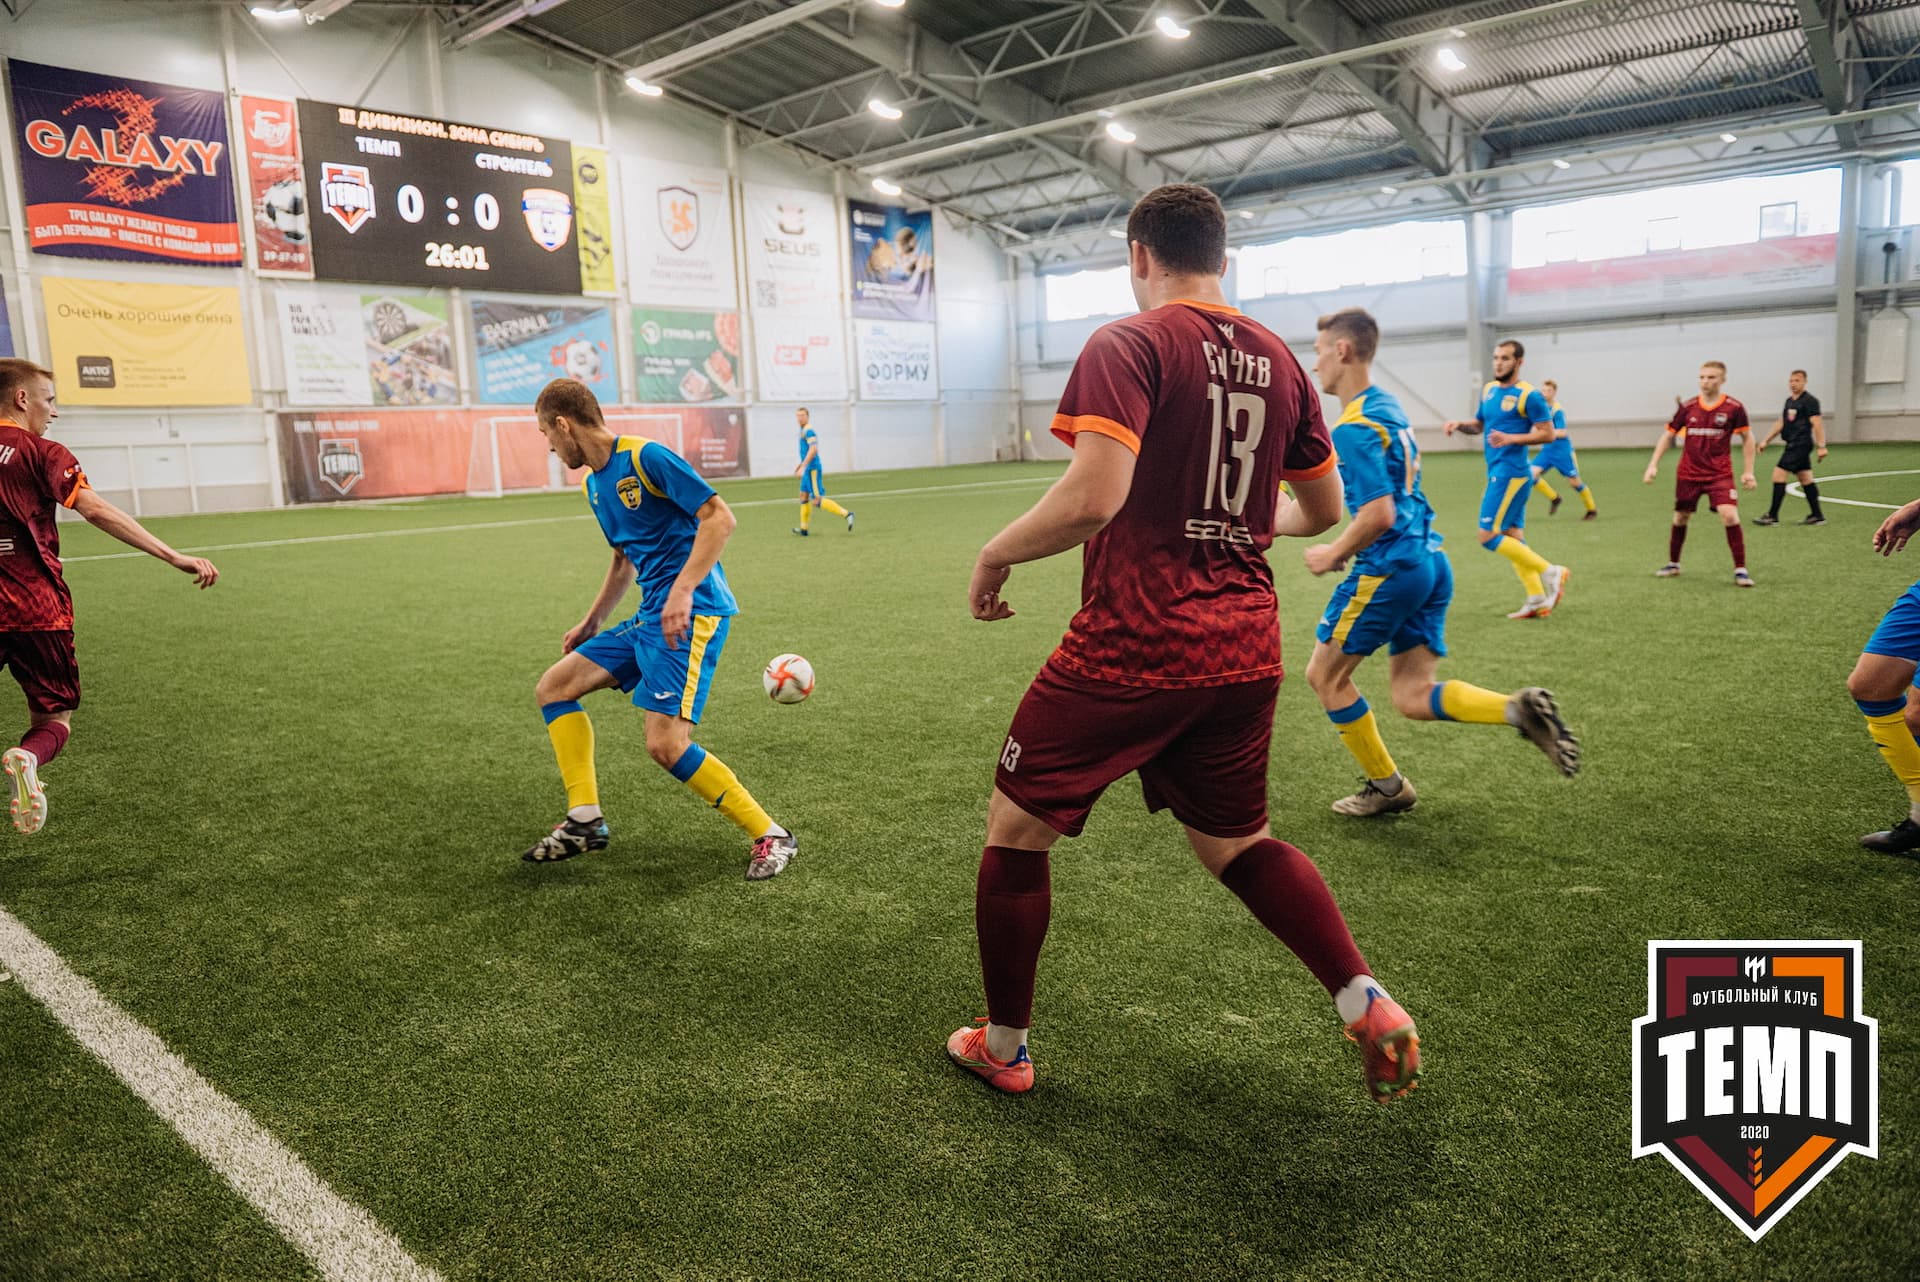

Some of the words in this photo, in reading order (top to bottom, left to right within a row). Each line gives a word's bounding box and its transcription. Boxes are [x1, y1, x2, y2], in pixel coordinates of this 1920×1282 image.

[25, 119, 223, 177] GALAXY
[355, 136, 401, 157] ТЕМП
[449, 124, 489, 145] ЗОНА
[489, 131, 545, 153] СИБИРЬ
[475, 153, 553, 177] СТРОИТЕЛЬ
[88, 210, 125, 226] GALAXY
[397, 184, 425, 223] 0
[473, 193, 500, 231] 0
[34, 225, 63, 239] БЫТЬ
[424, 242, 490, 271] 26:01
[764, 239, 821, 257] SEUS
[57, 303, 113, 320] Очень
[117, 309, 192, 324] хорошие
[82, 366, 111, 376] АКТО
[866, 363, 930, 381] ФОРМУ
[1203, 382, 1267, 517] 13
[1000, 735, 1022, 773] 13
